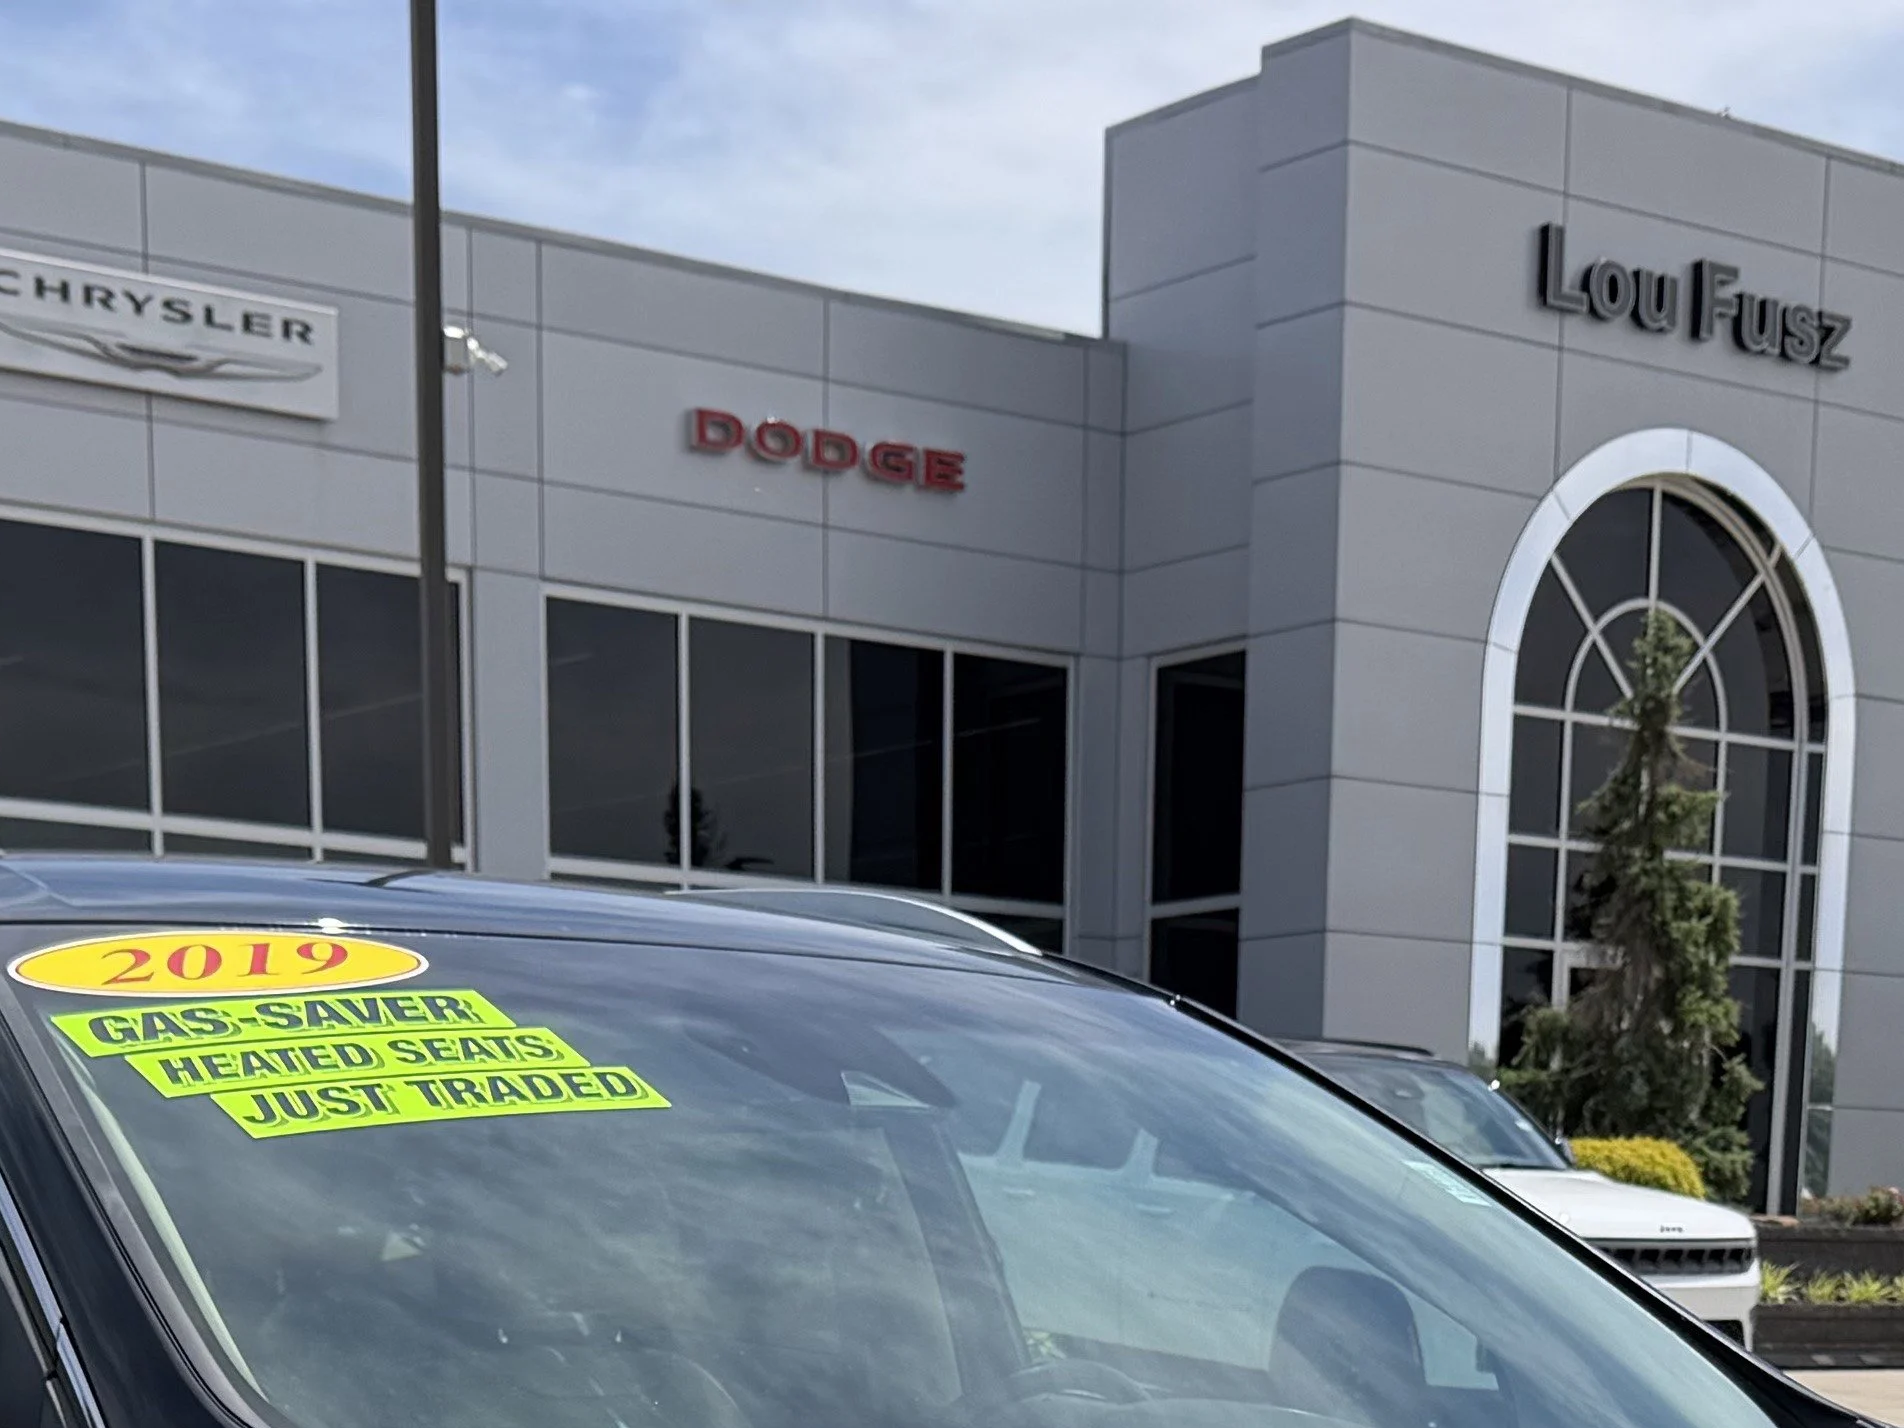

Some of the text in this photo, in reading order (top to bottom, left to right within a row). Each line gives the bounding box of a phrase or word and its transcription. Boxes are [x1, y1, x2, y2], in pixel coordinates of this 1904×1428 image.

[1538, 221, 1853, 372] Lou Fusz
[690, 406, 966, 492] DODGE
[101, 942, 349, 986] 2019
[88, 995, 486, 1047] GAS-SAVER
[158, 1034, 565, 1087] HEATED SEATS
[242, 1071, 650, 1128] JUST TRADED
